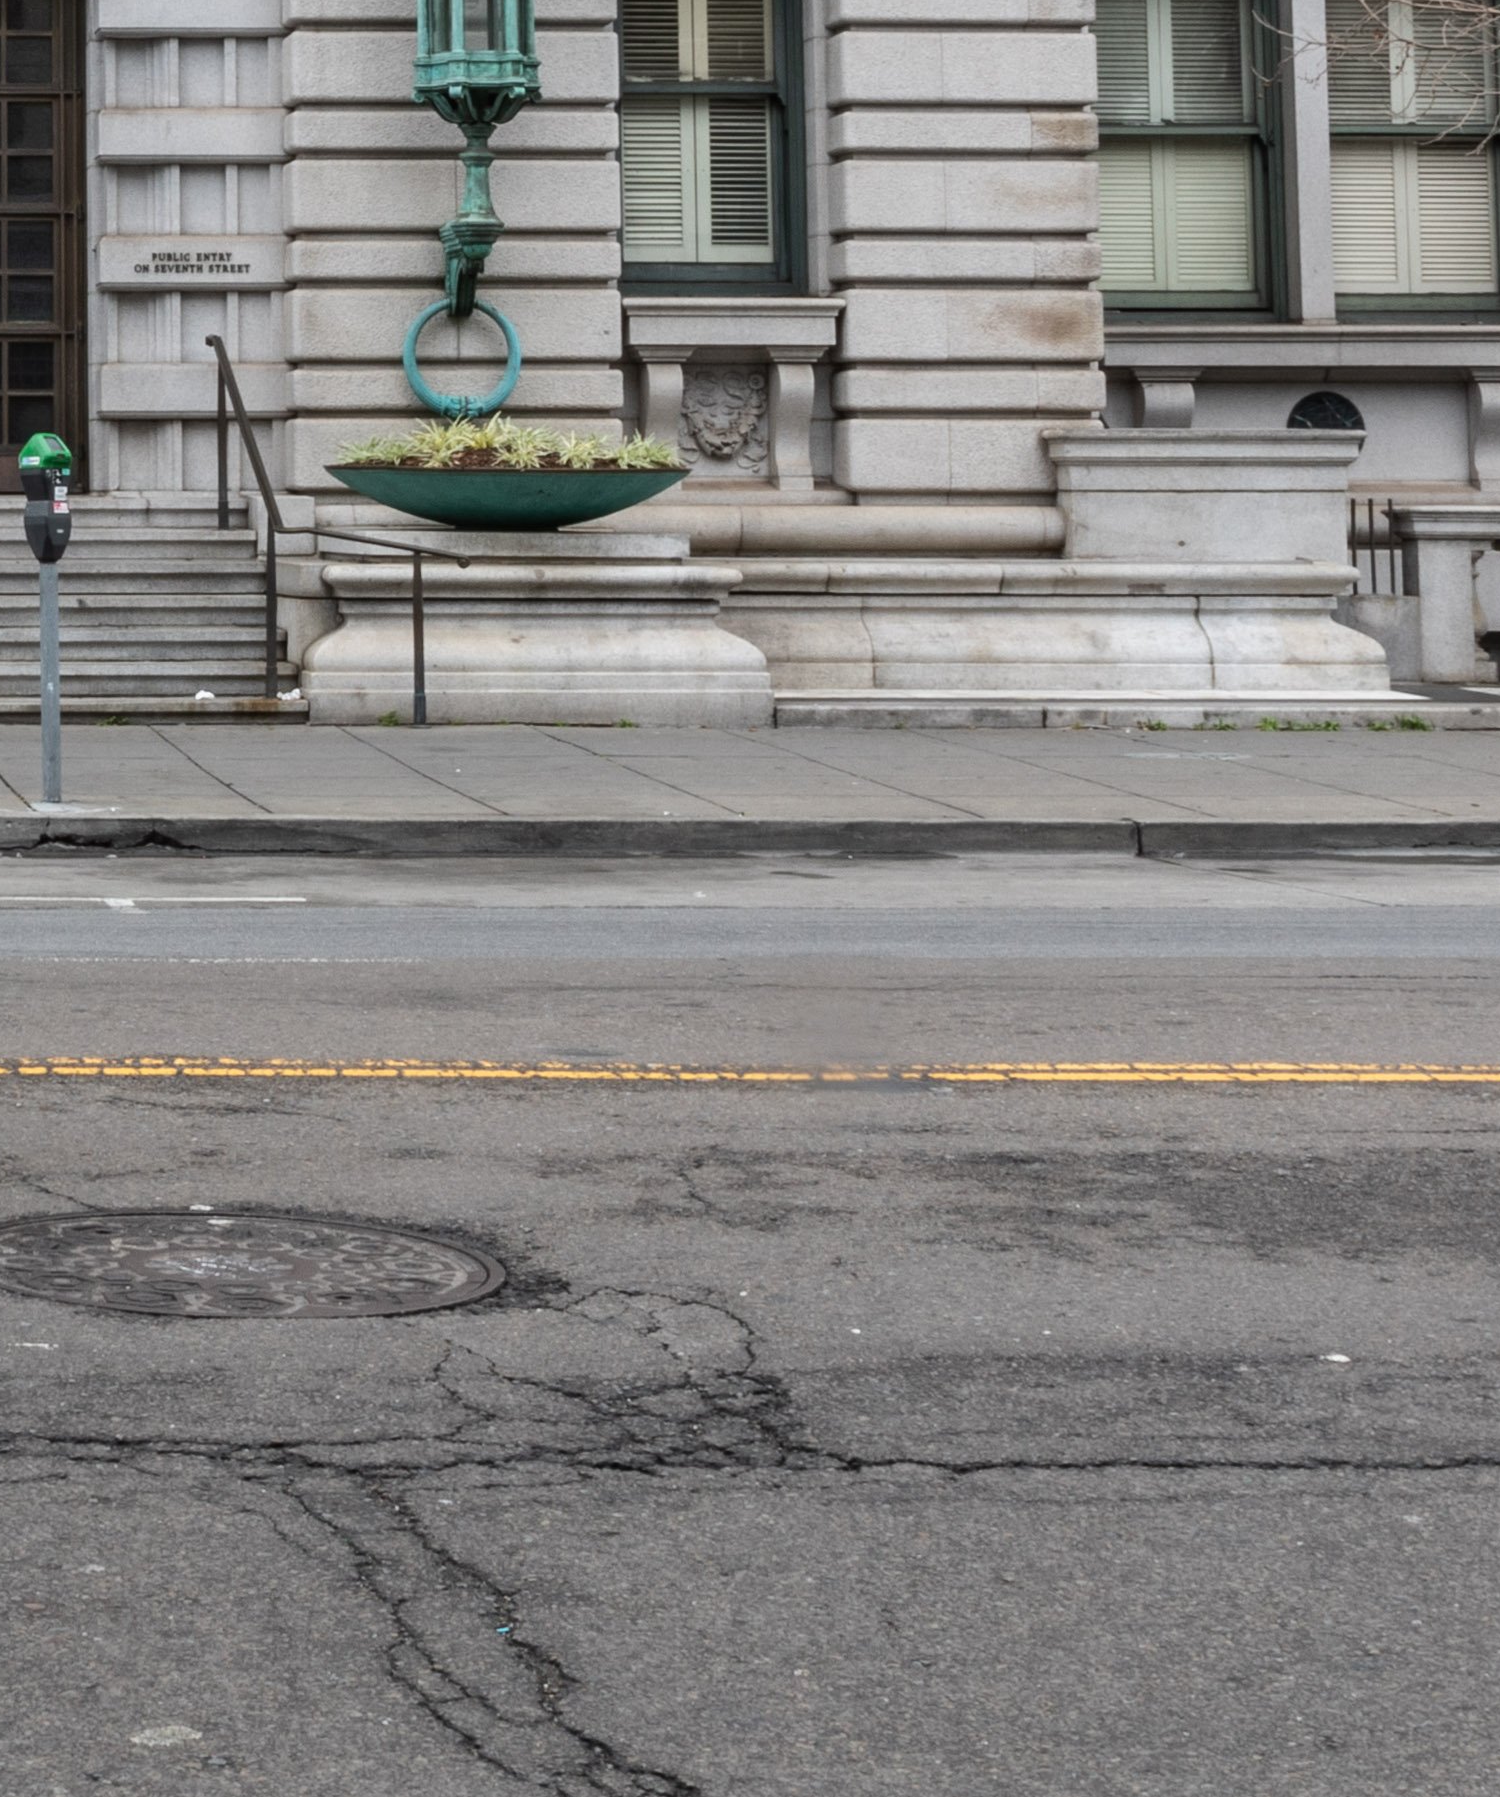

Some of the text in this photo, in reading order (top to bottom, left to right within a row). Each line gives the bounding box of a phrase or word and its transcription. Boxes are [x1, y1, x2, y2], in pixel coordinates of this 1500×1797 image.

[152, 252, 232, 262] PUBLIC ENTRY
[134, 264, 250, 273] ON SEVENTH STREET
